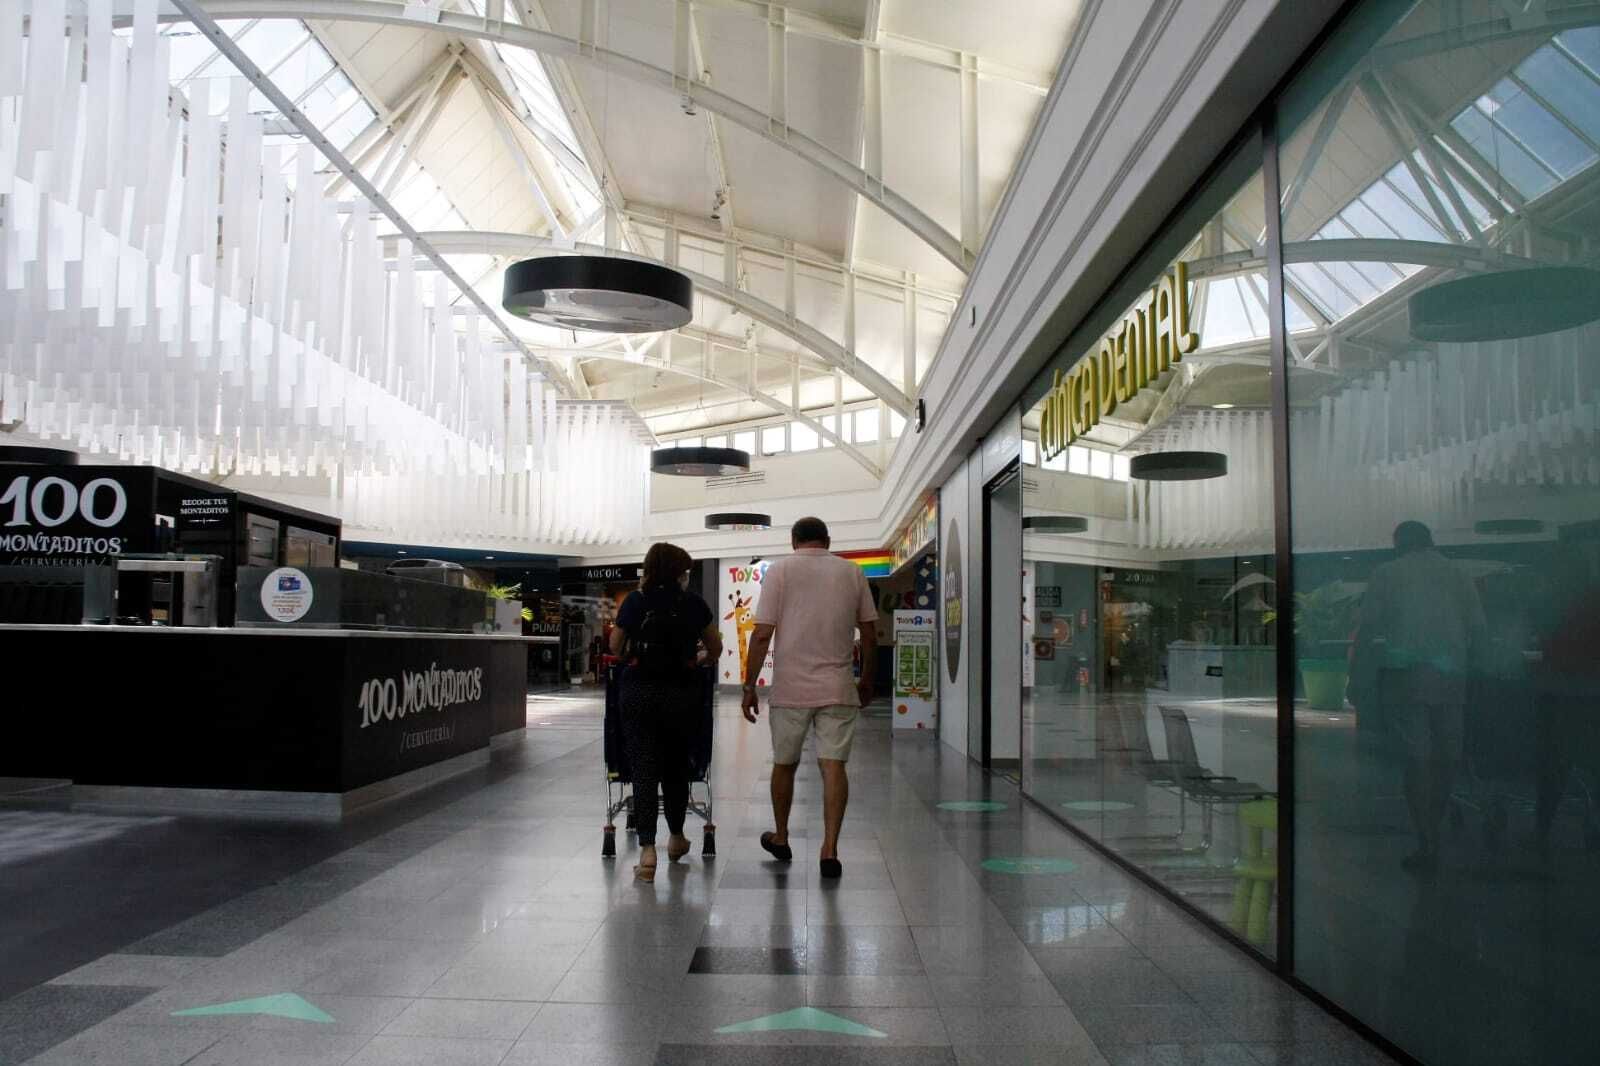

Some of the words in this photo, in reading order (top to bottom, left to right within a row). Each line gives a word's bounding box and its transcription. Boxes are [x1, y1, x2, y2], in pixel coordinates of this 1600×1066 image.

[0, 475, 128, 528] 100
[358, 677, 398, 729] 100
[397, 661, 483, 719] MONTADITOS
